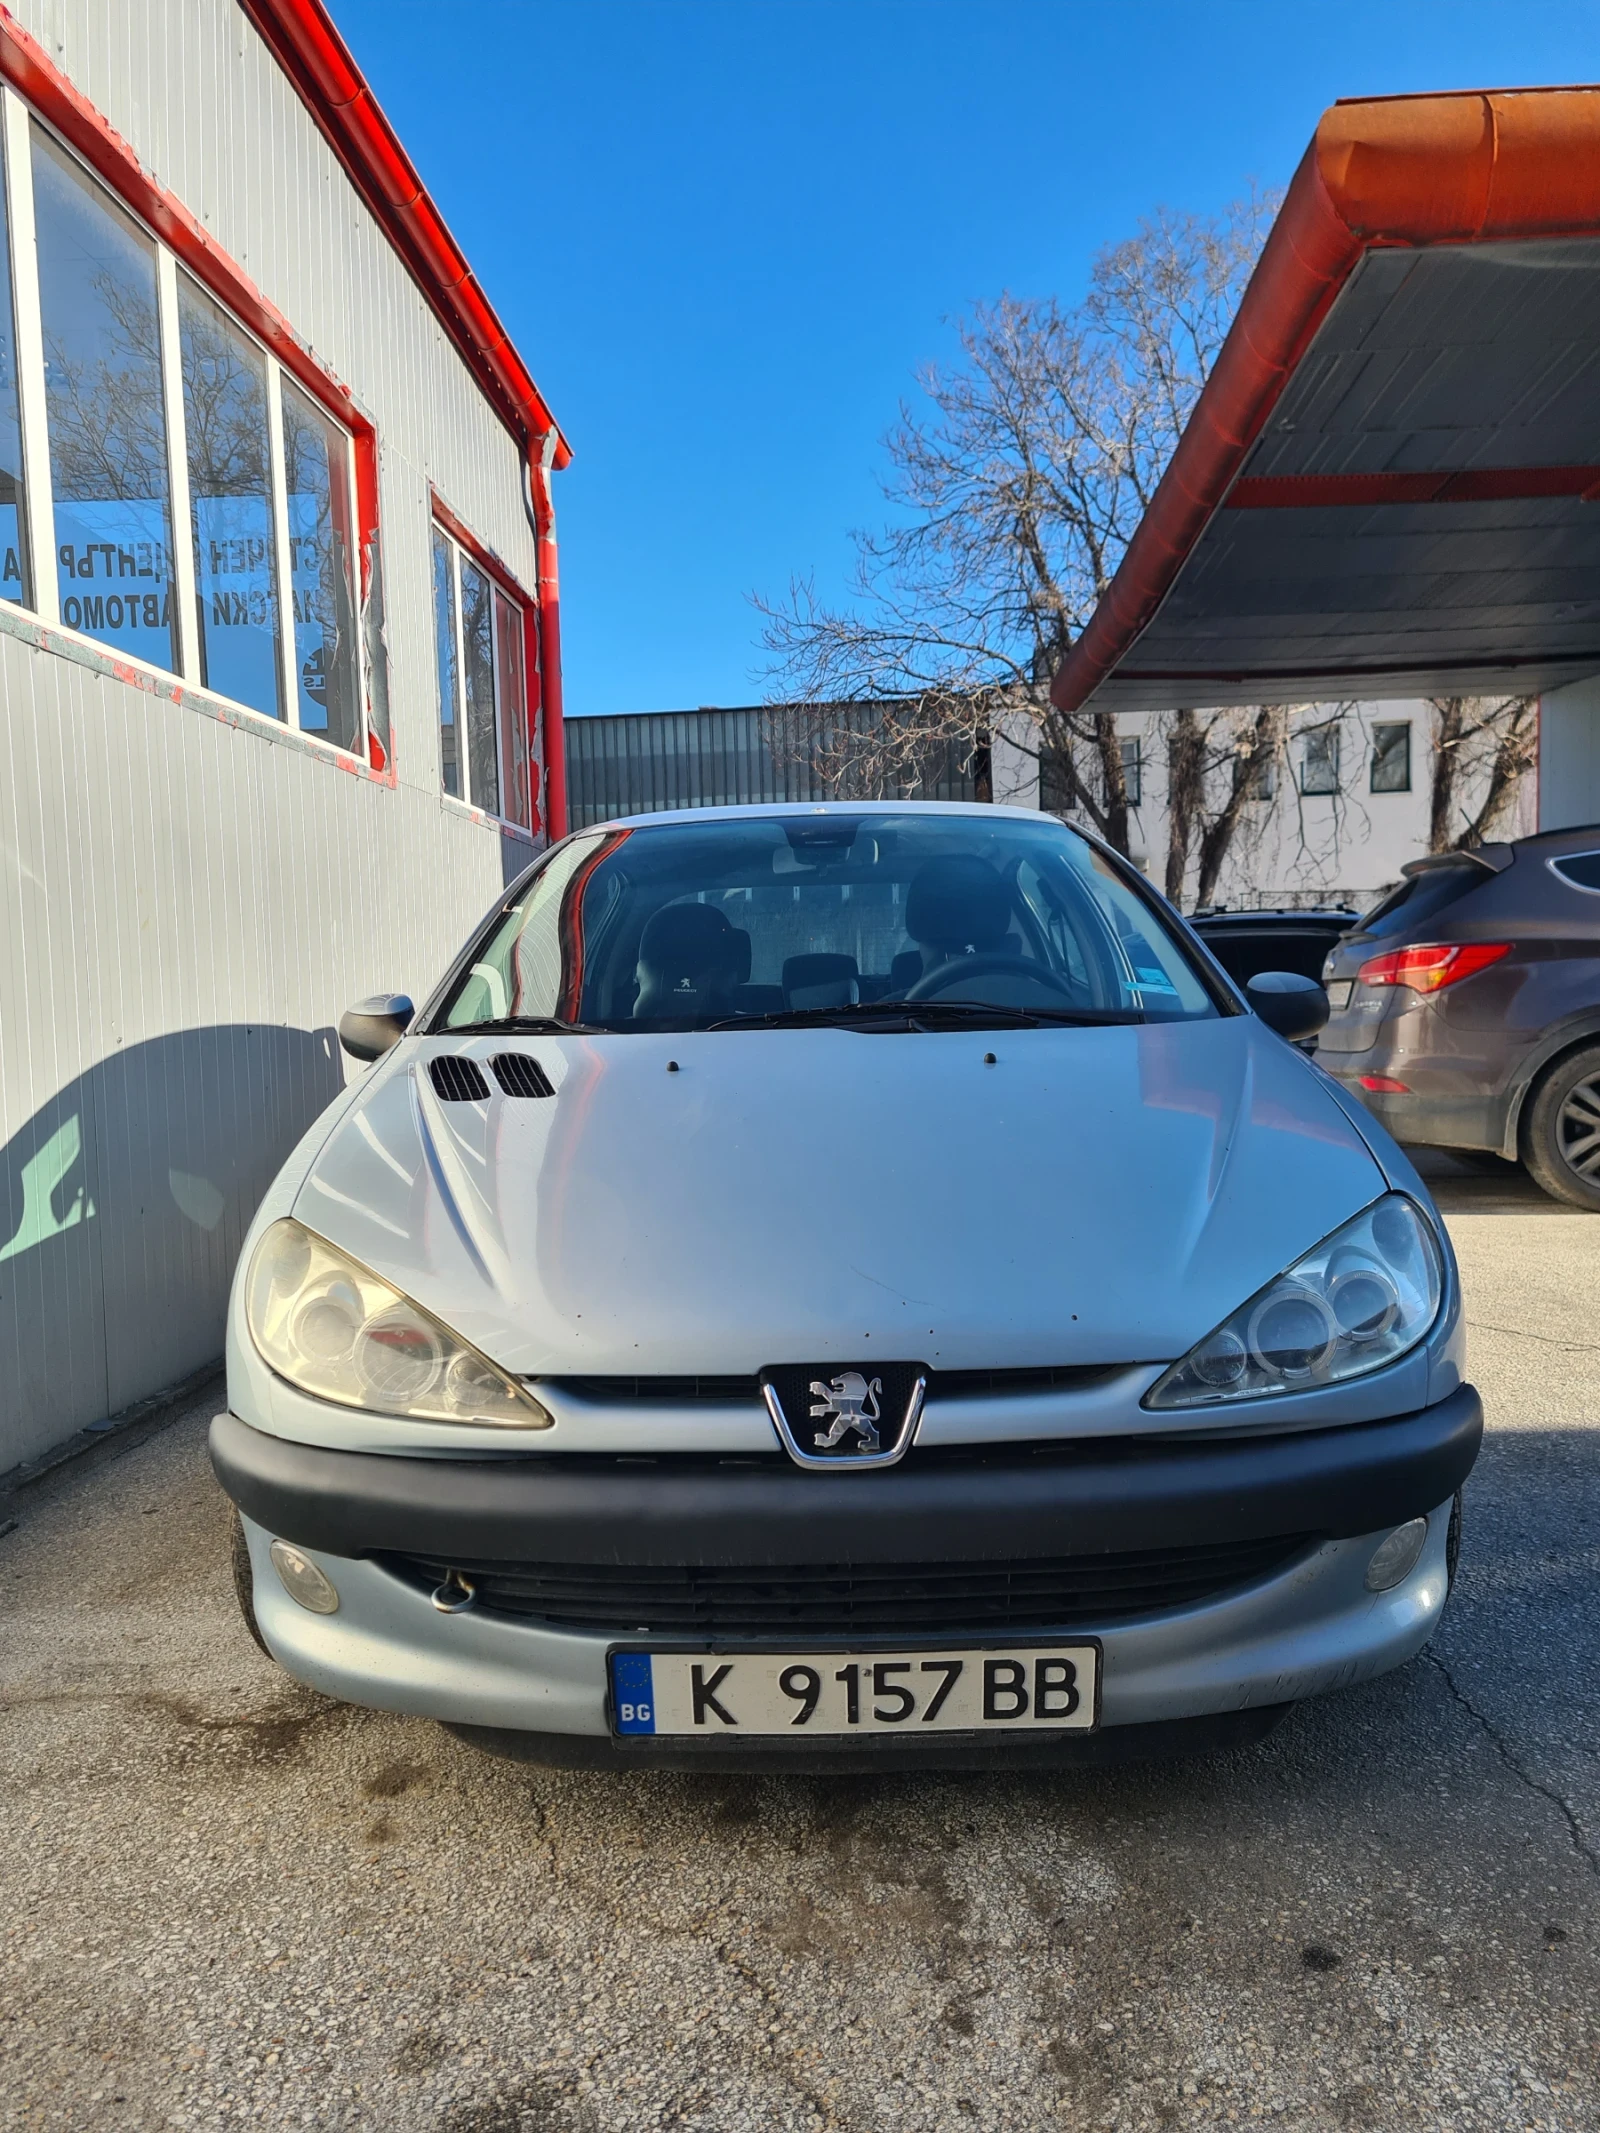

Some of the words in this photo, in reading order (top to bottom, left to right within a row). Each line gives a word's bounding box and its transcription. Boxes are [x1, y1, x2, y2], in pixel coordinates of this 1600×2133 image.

[621, 1703, 651, 1721] BG
[690, 1664, 739, 1725] K
[778, 1660, 963, 1725] 9157
[982, 1658, 1080, 1720] BB
